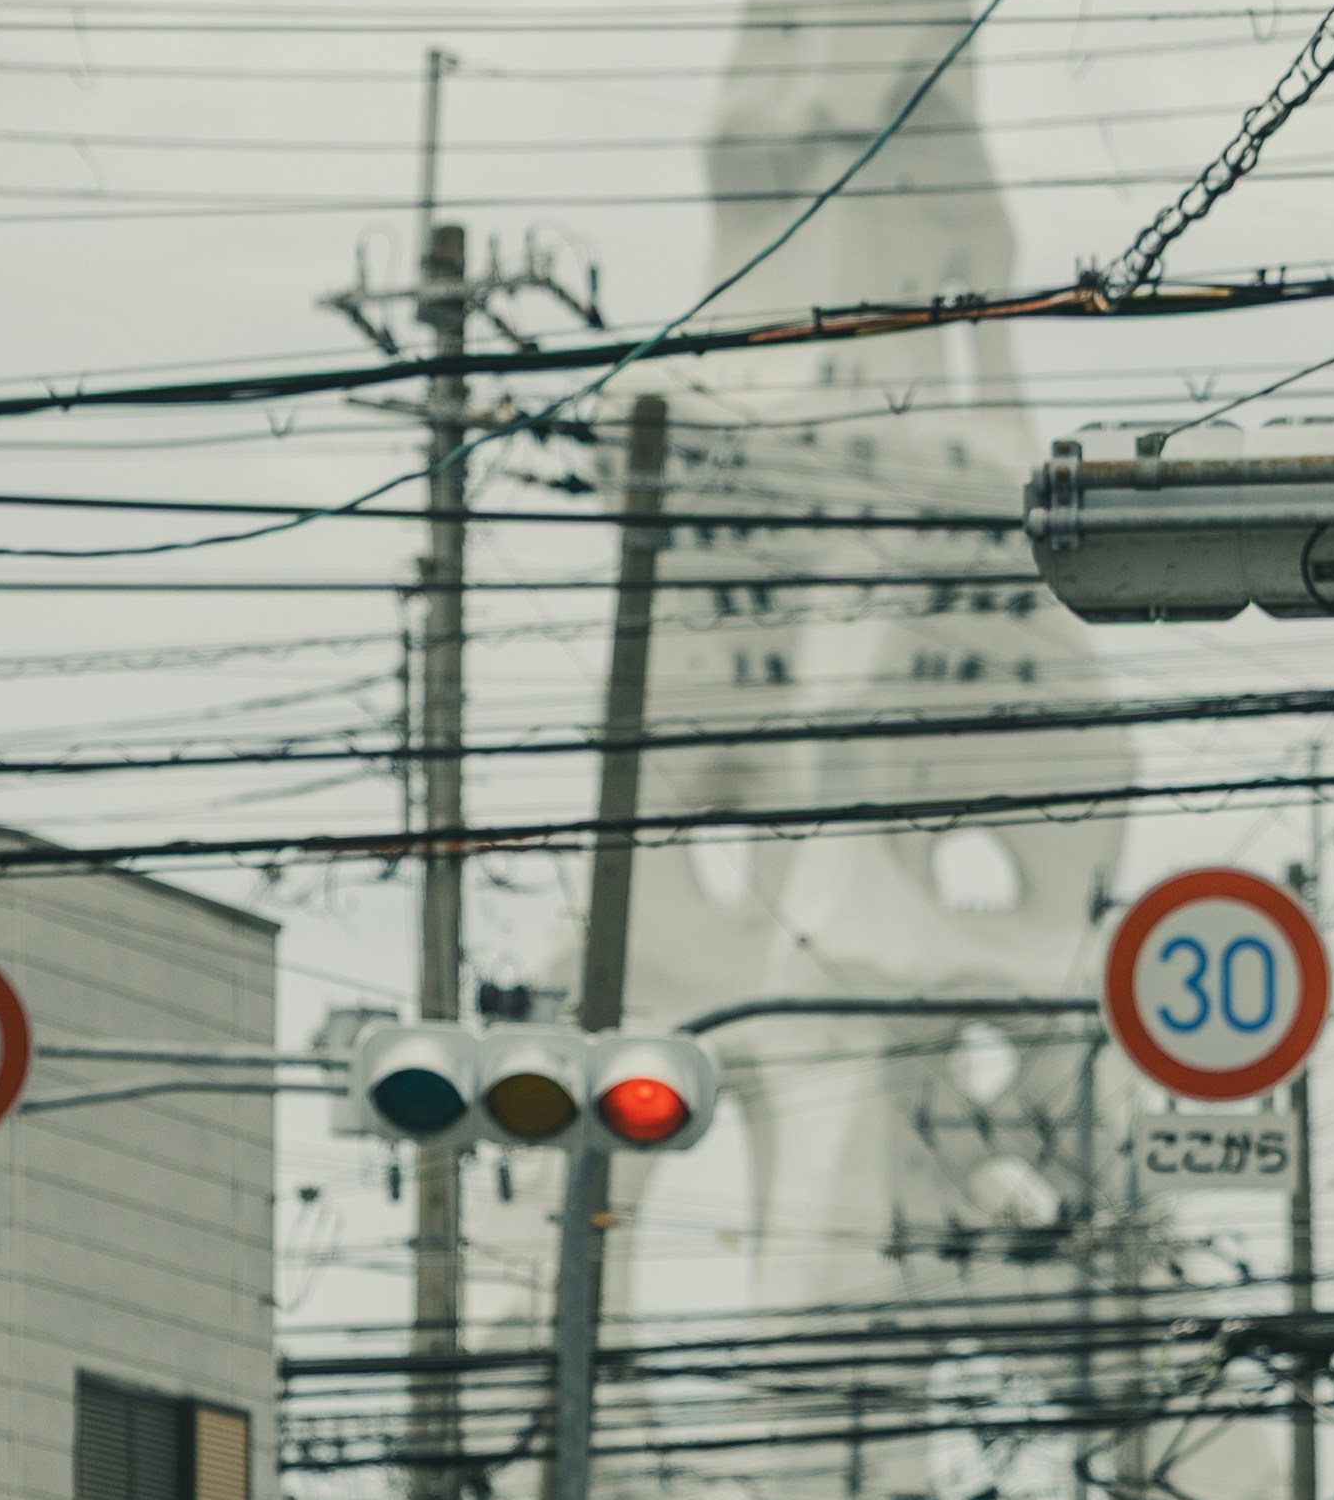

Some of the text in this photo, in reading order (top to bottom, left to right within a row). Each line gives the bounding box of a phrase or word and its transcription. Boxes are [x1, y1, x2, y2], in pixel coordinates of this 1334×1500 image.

[1159, 936, 1277, 1034] 30
[1146, 1130, 1288, 1175] ここから
